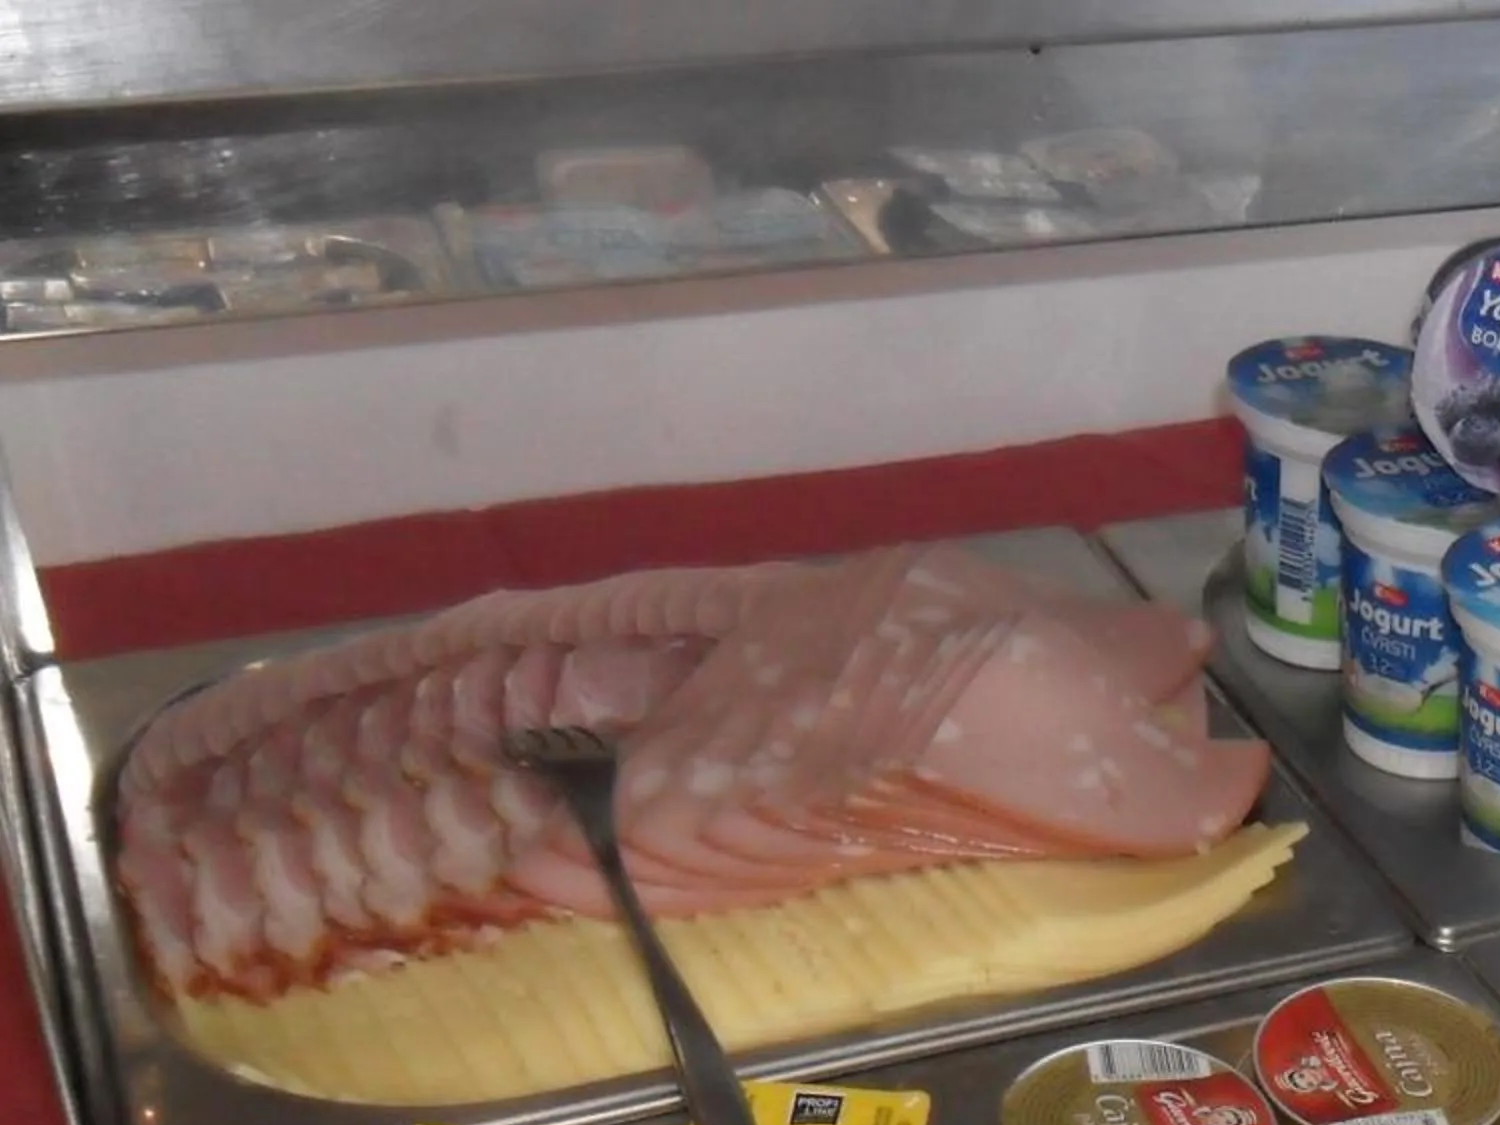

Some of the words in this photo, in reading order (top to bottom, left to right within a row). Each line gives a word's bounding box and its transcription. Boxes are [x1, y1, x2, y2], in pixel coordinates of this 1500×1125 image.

[1353, 451, 1447, 480] Jogu
[1350, 586, 1444, 642] Jogurt
[796, 1096, 839, 1110] PROFI
